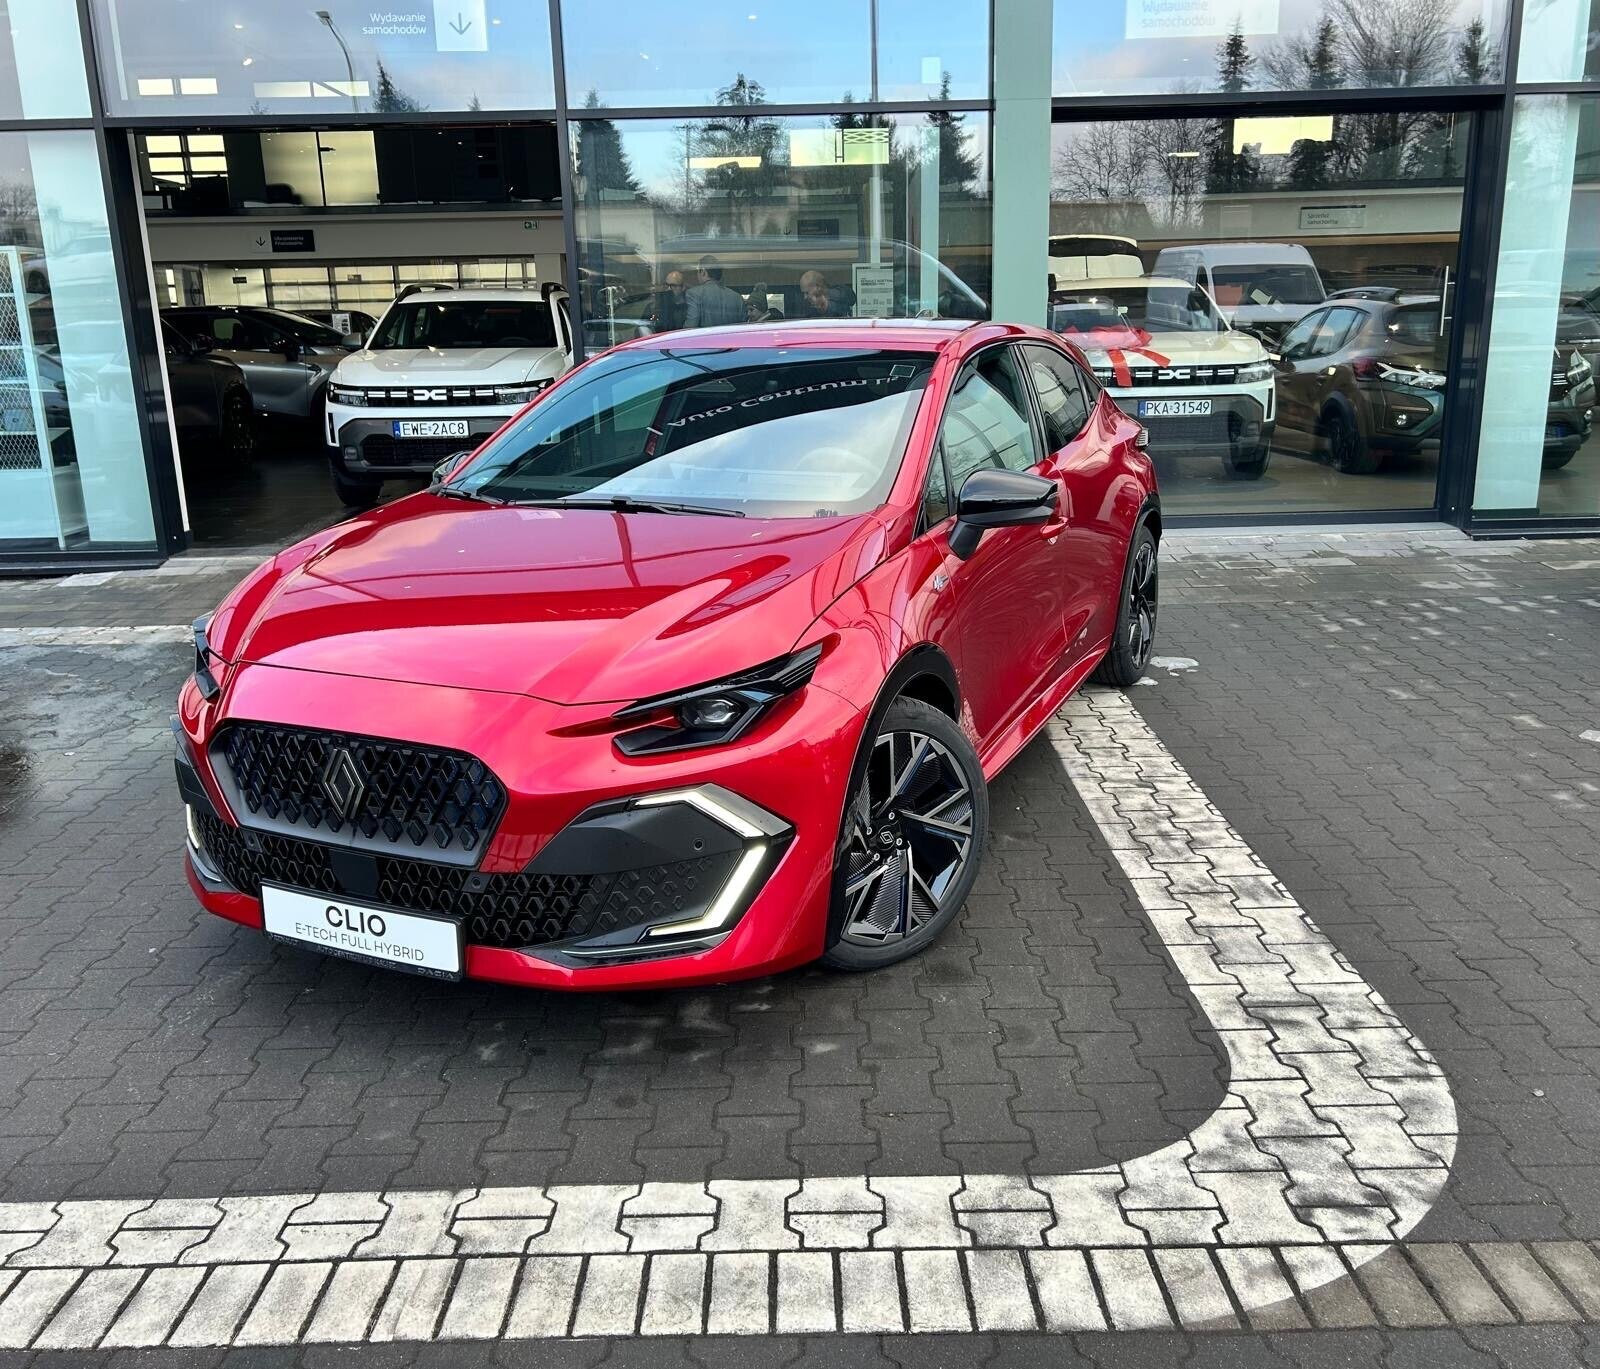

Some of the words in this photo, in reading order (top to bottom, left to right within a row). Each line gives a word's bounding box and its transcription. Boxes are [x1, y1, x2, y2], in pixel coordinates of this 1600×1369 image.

[369, 12, 426, 24] Wydawanie
[1142, 15, 1216, 28] samochodów
[362, 24, 427, 35] samochodów
[1146, 402, 1170, 414] PKA
[1173, 402, 1210, 414] 31549
[402, 422, 428, 436] EWE
[432, 422, 465, 436] 2AC8
[325, 905, 387, 937] CLIO
[295, 922, 338, 943] E-TECH
[341, 933, 373, 951] FULL
[374, 939, 425, 962] HYBRID
[416, 966, 455, 980] DACIA
